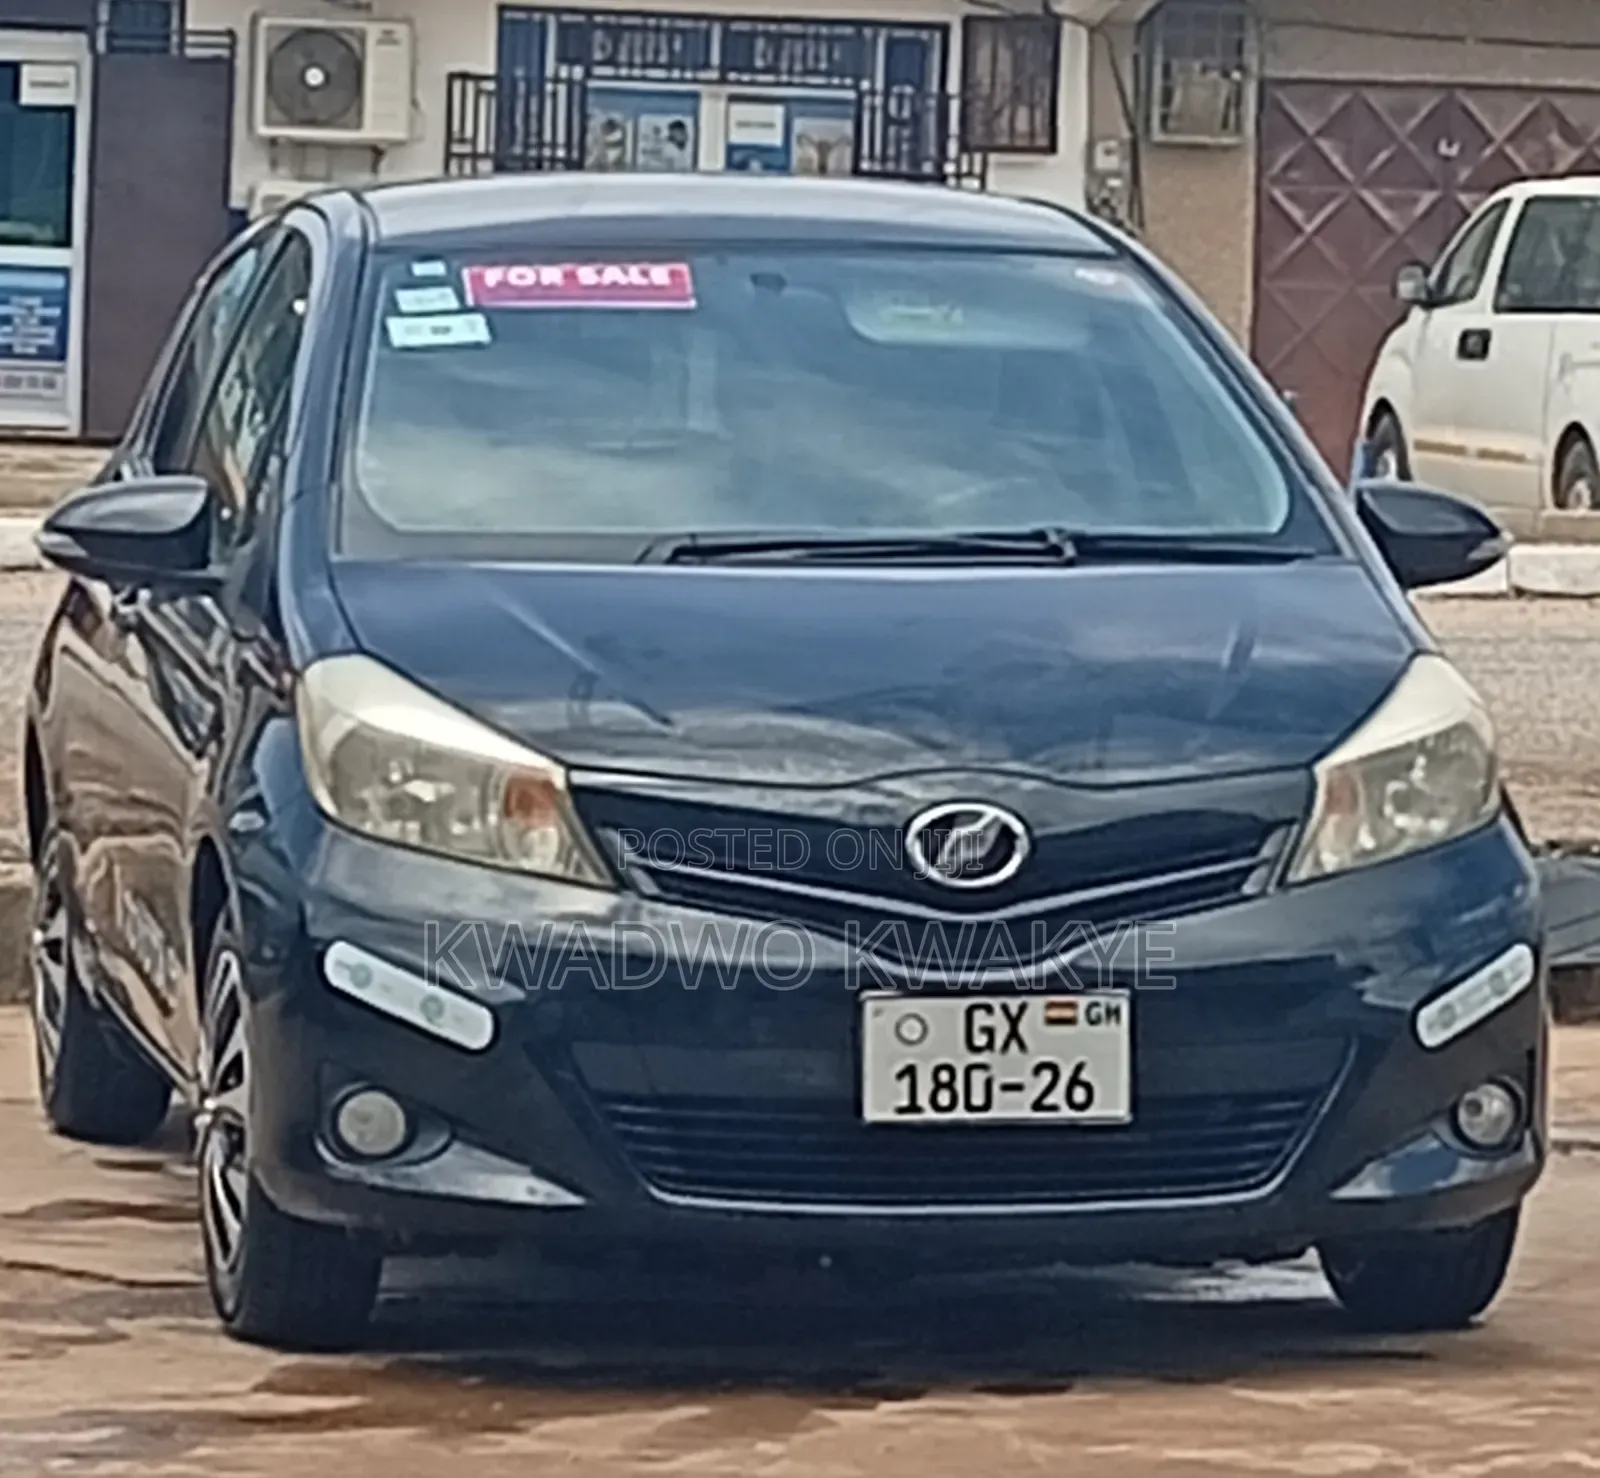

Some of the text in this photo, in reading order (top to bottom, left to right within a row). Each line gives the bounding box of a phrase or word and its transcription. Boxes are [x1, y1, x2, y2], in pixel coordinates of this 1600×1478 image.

[483, 264, 673, 288] FOR SALE
[963, 1001, 1029, 1055] GX
[893, 1060, 1096, 1115] 180-26
